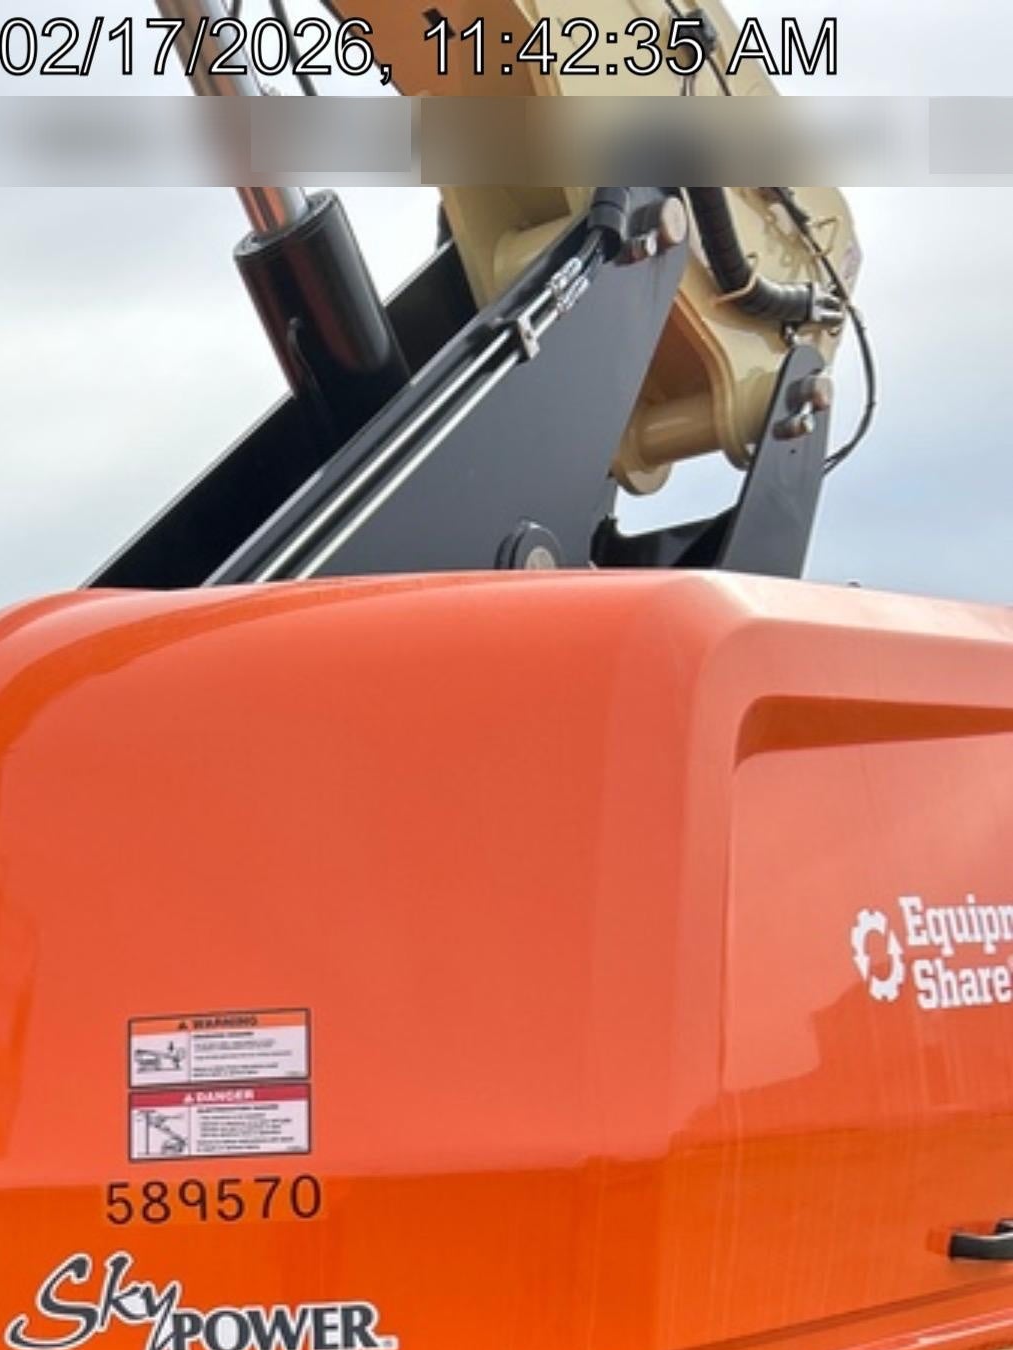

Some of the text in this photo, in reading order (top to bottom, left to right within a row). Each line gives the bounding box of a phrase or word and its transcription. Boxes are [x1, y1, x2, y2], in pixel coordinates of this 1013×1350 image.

[912, 957, 1013, 1010] Share
[192, 1016, 258, 1030] WARNING
[195, 1090, 255, 1104] DANGER
[106, 1174, 323, 1226] 589570
